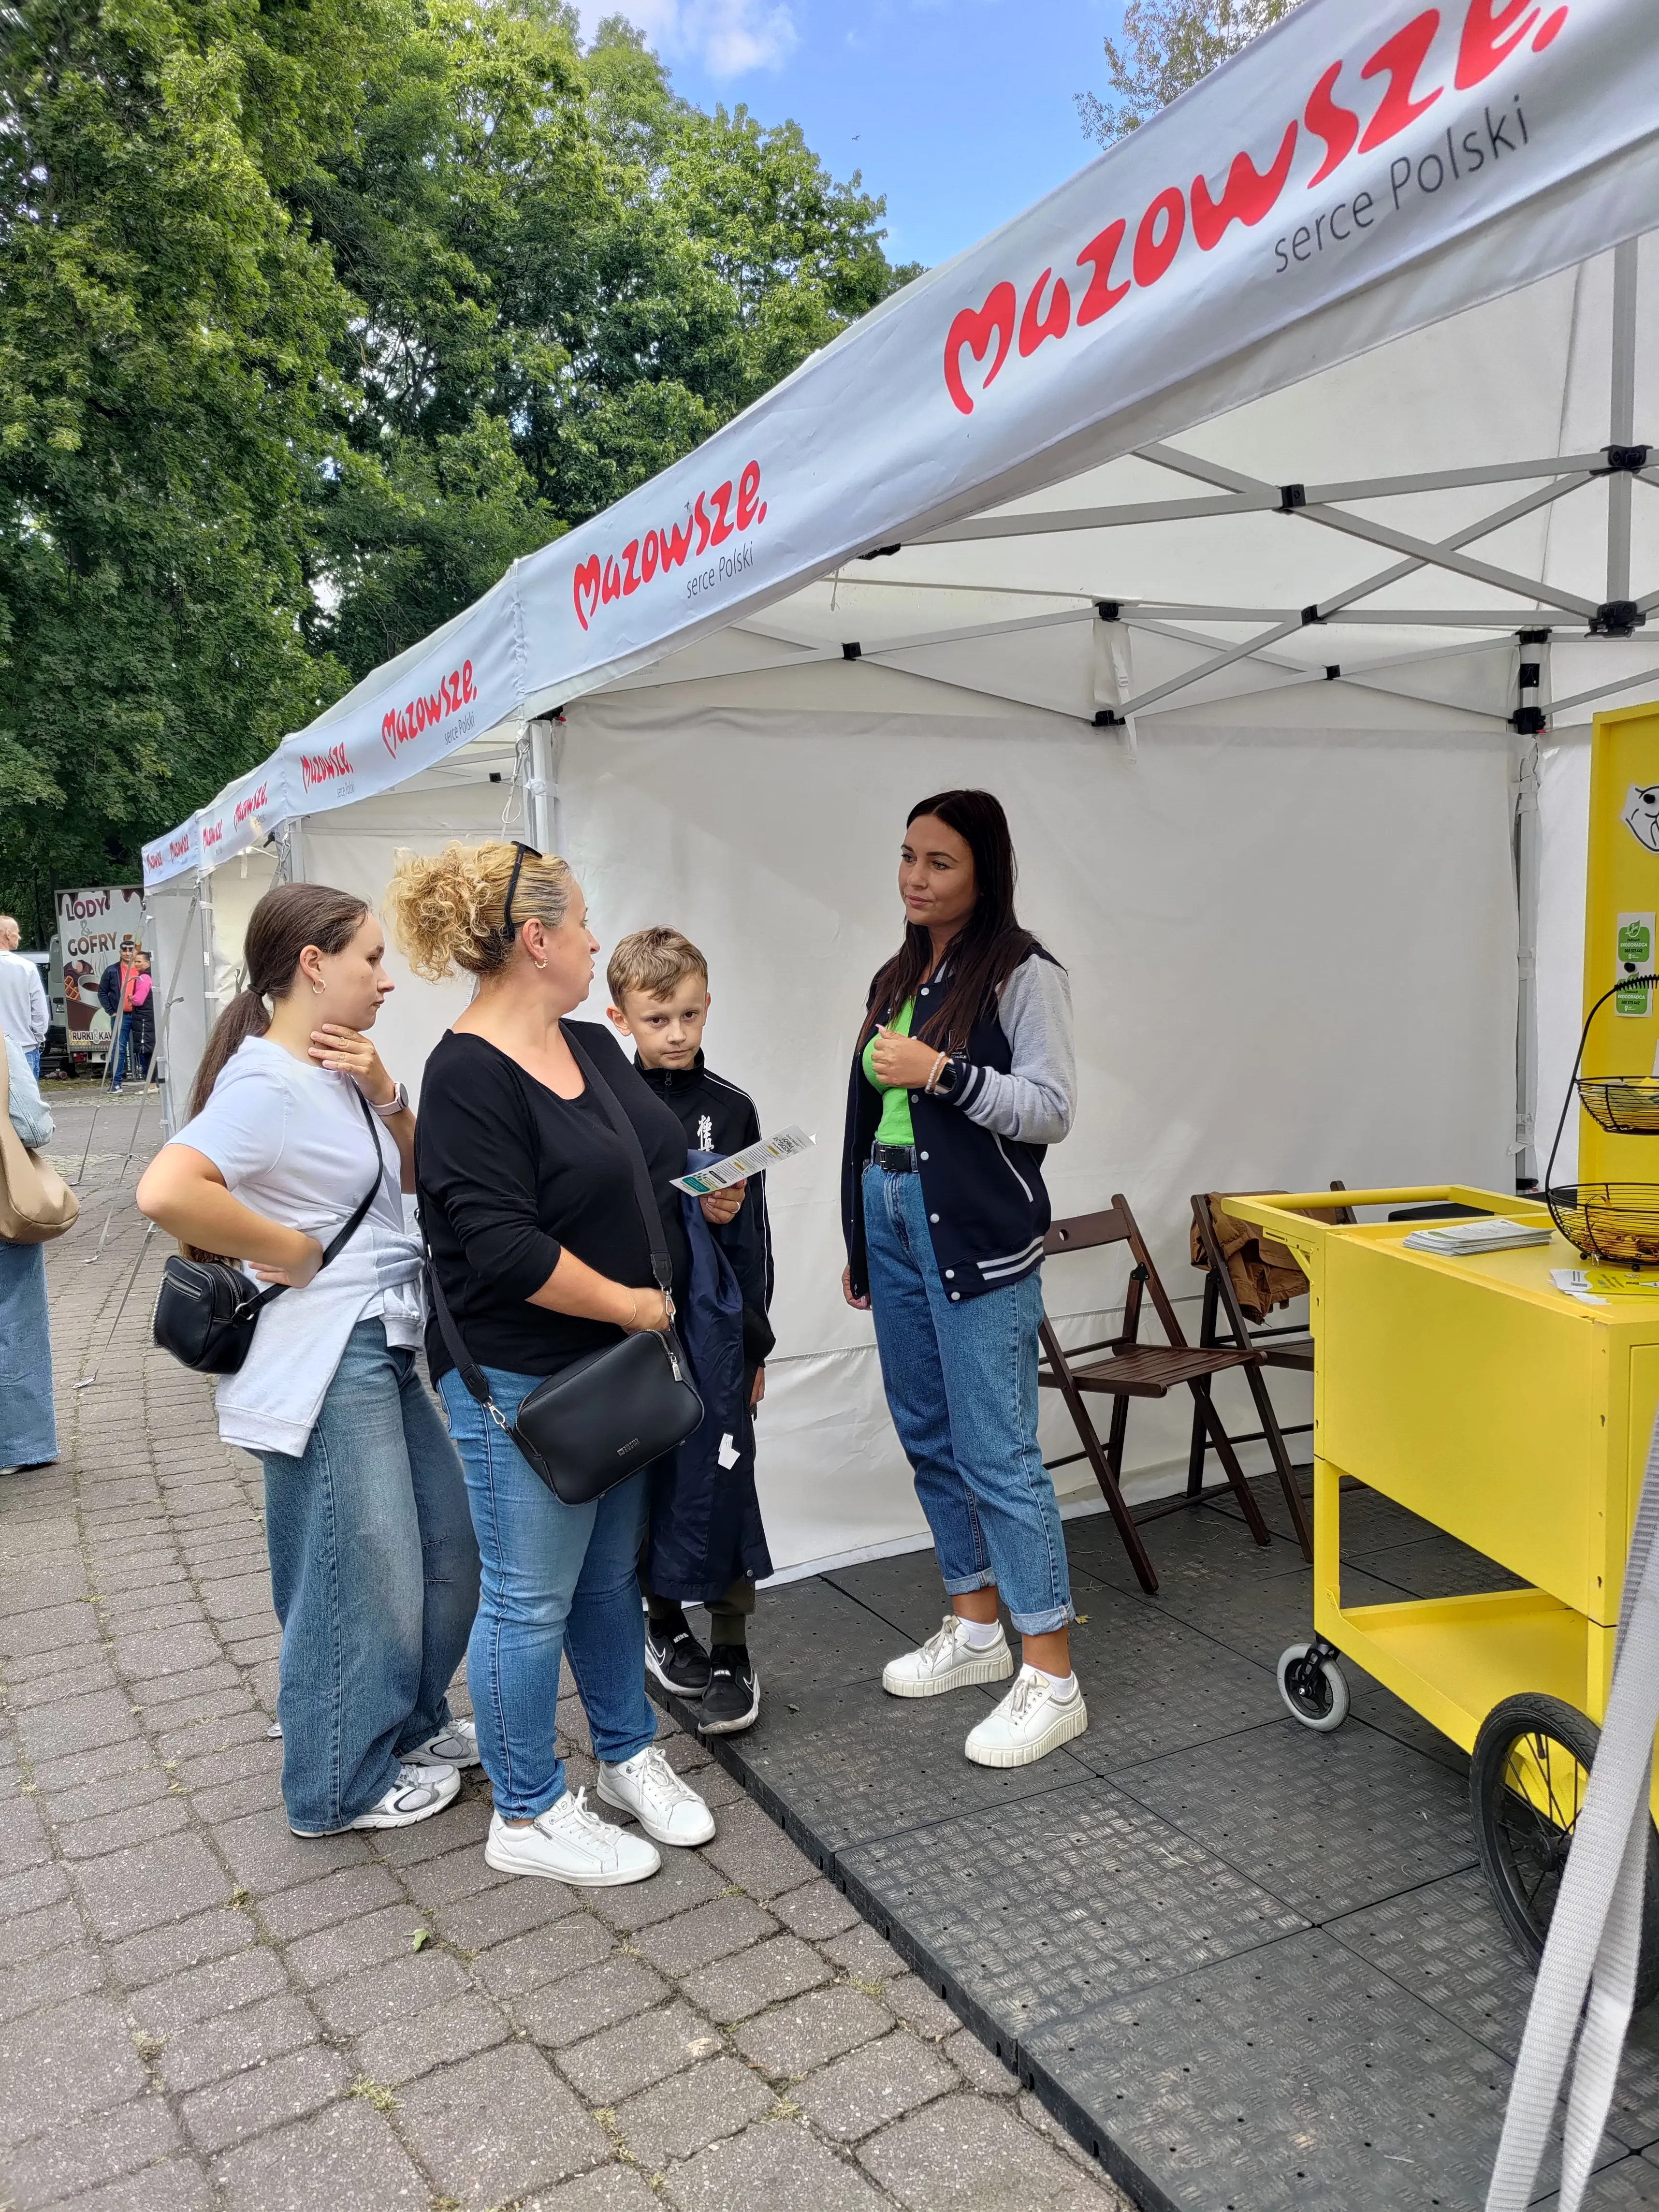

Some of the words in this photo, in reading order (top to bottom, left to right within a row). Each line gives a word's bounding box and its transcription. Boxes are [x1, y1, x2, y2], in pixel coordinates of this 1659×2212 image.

[1274, 191, 1375, 274] serce
[1390, 94, 1529, 210] Polski
[686, 568, 715, 599] serce
[719, 540, 753, 582] Polski
[444, 726, 459, 745] serce
[458, 710, 475, 736] Polski
[65, 897, 105, 921] LODY
[67, 931, 117, 957] GOFRY
[72, 1031, 93, 1040] RURKI
[672, 1632, 689, 1644] NIKE
